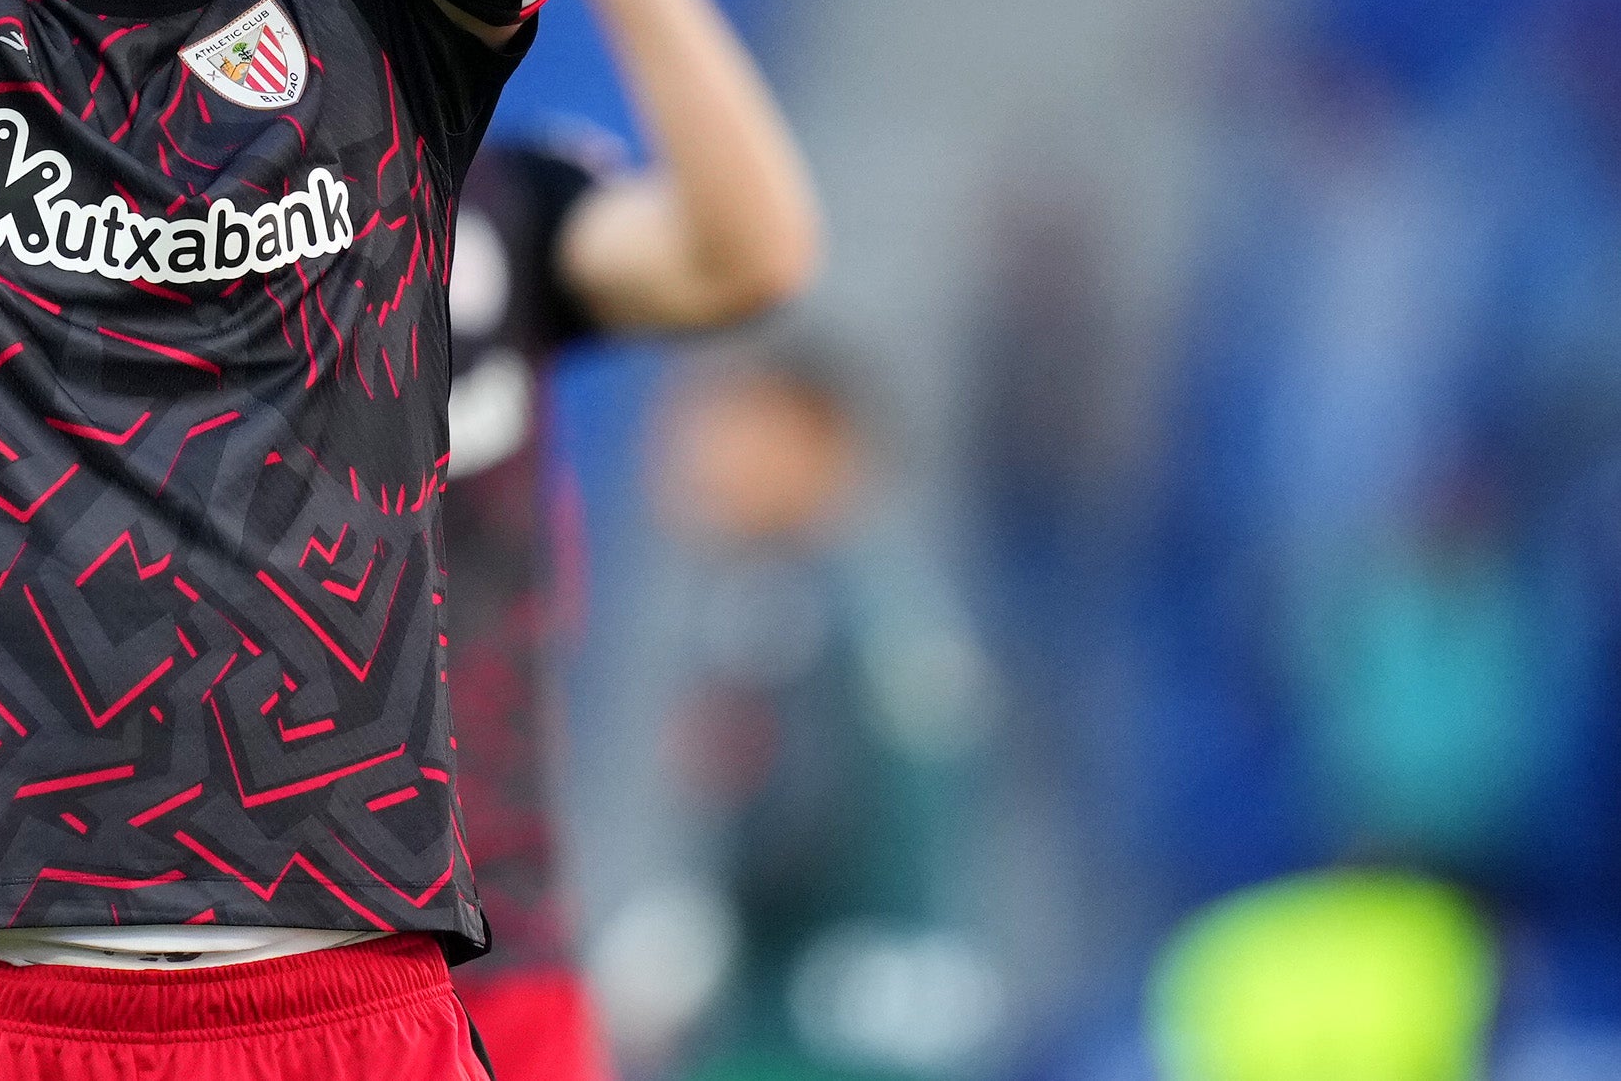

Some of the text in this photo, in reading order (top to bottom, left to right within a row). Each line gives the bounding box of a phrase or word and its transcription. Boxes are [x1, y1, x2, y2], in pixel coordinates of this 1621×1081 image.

[195, 9, 270, 61] ATHLETIC CLUB
[260, 72, 299, 103] BILBAO
